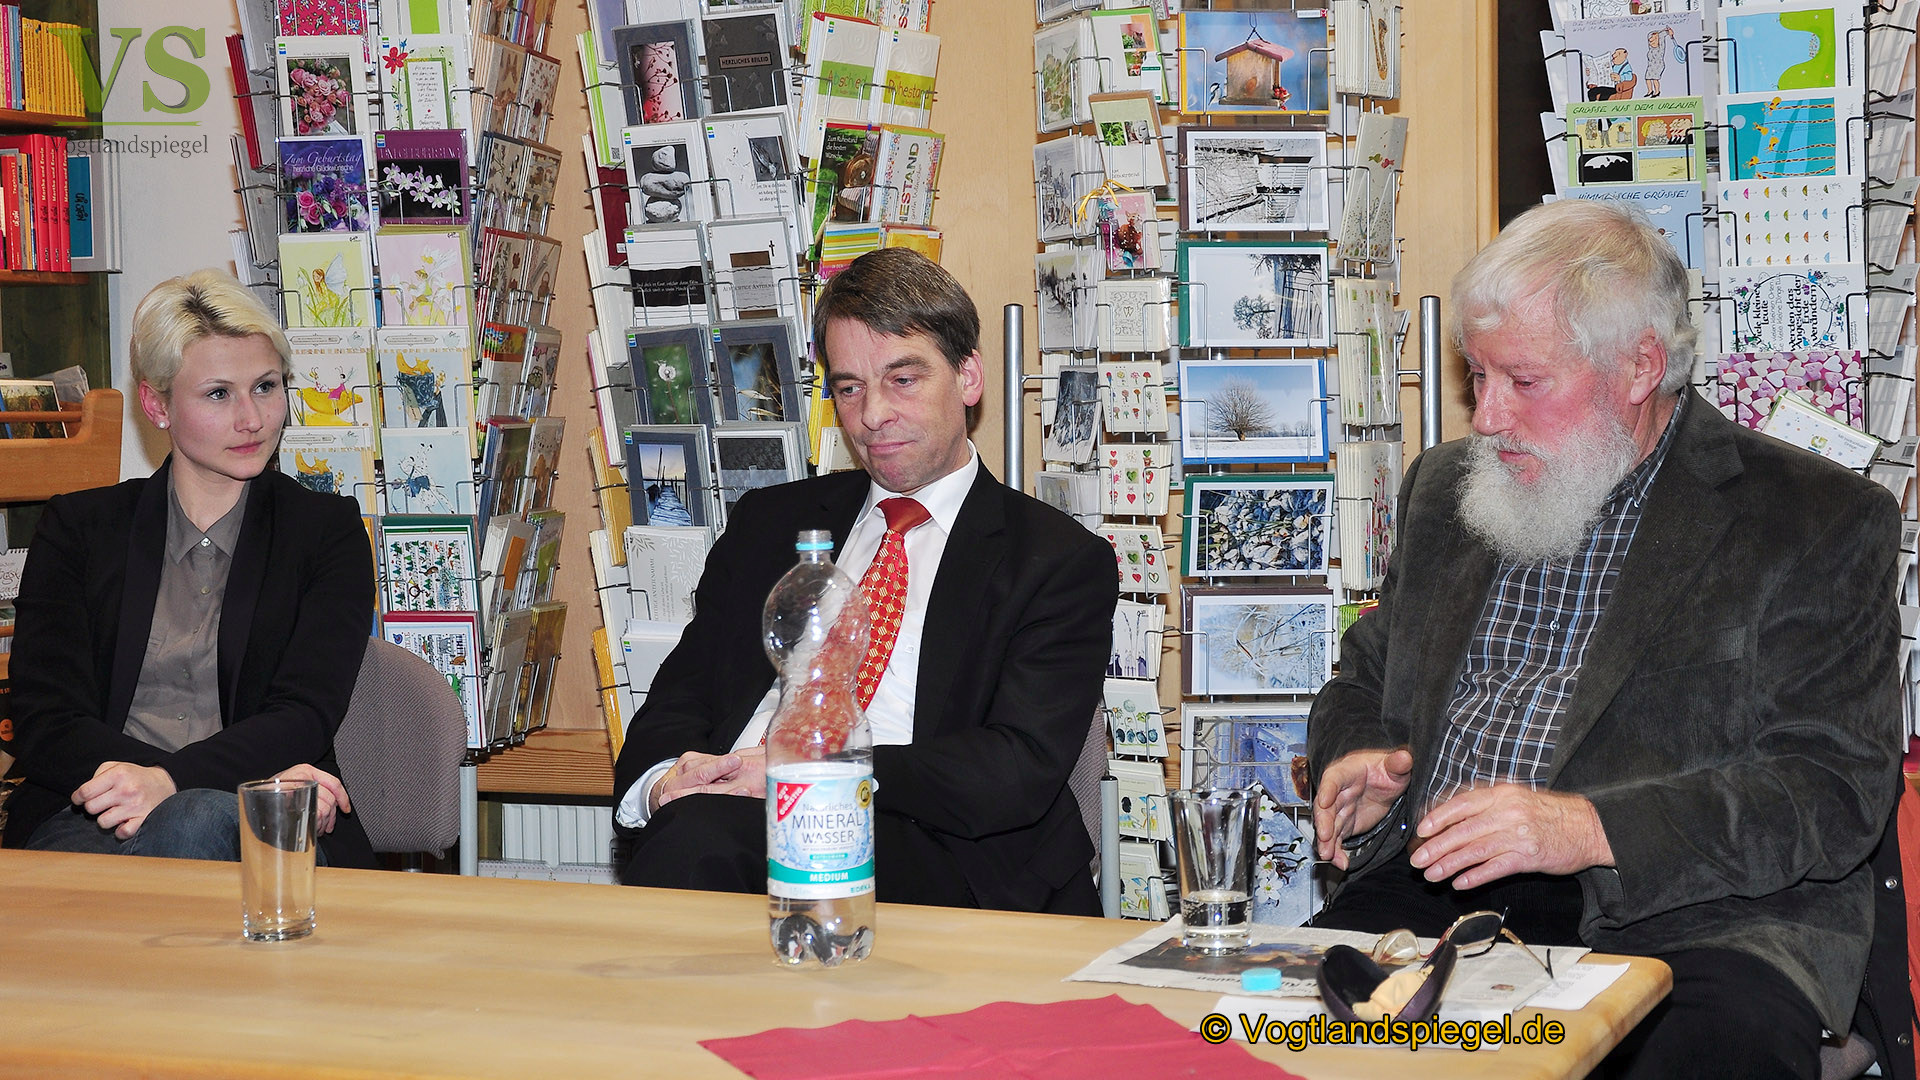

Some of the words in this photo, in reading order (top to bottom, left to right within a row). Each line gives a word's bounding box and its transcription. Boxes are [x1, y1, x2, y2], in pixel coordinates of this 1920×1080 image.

[1611, 104, 1631, 112] AUS
[1634, 103, 1654, 111] DEM
[791, 811, 863, 830] MINERAL
[801, 830, 856, 844] WASSER
[809, 871, 849, 883] MEDIUM
